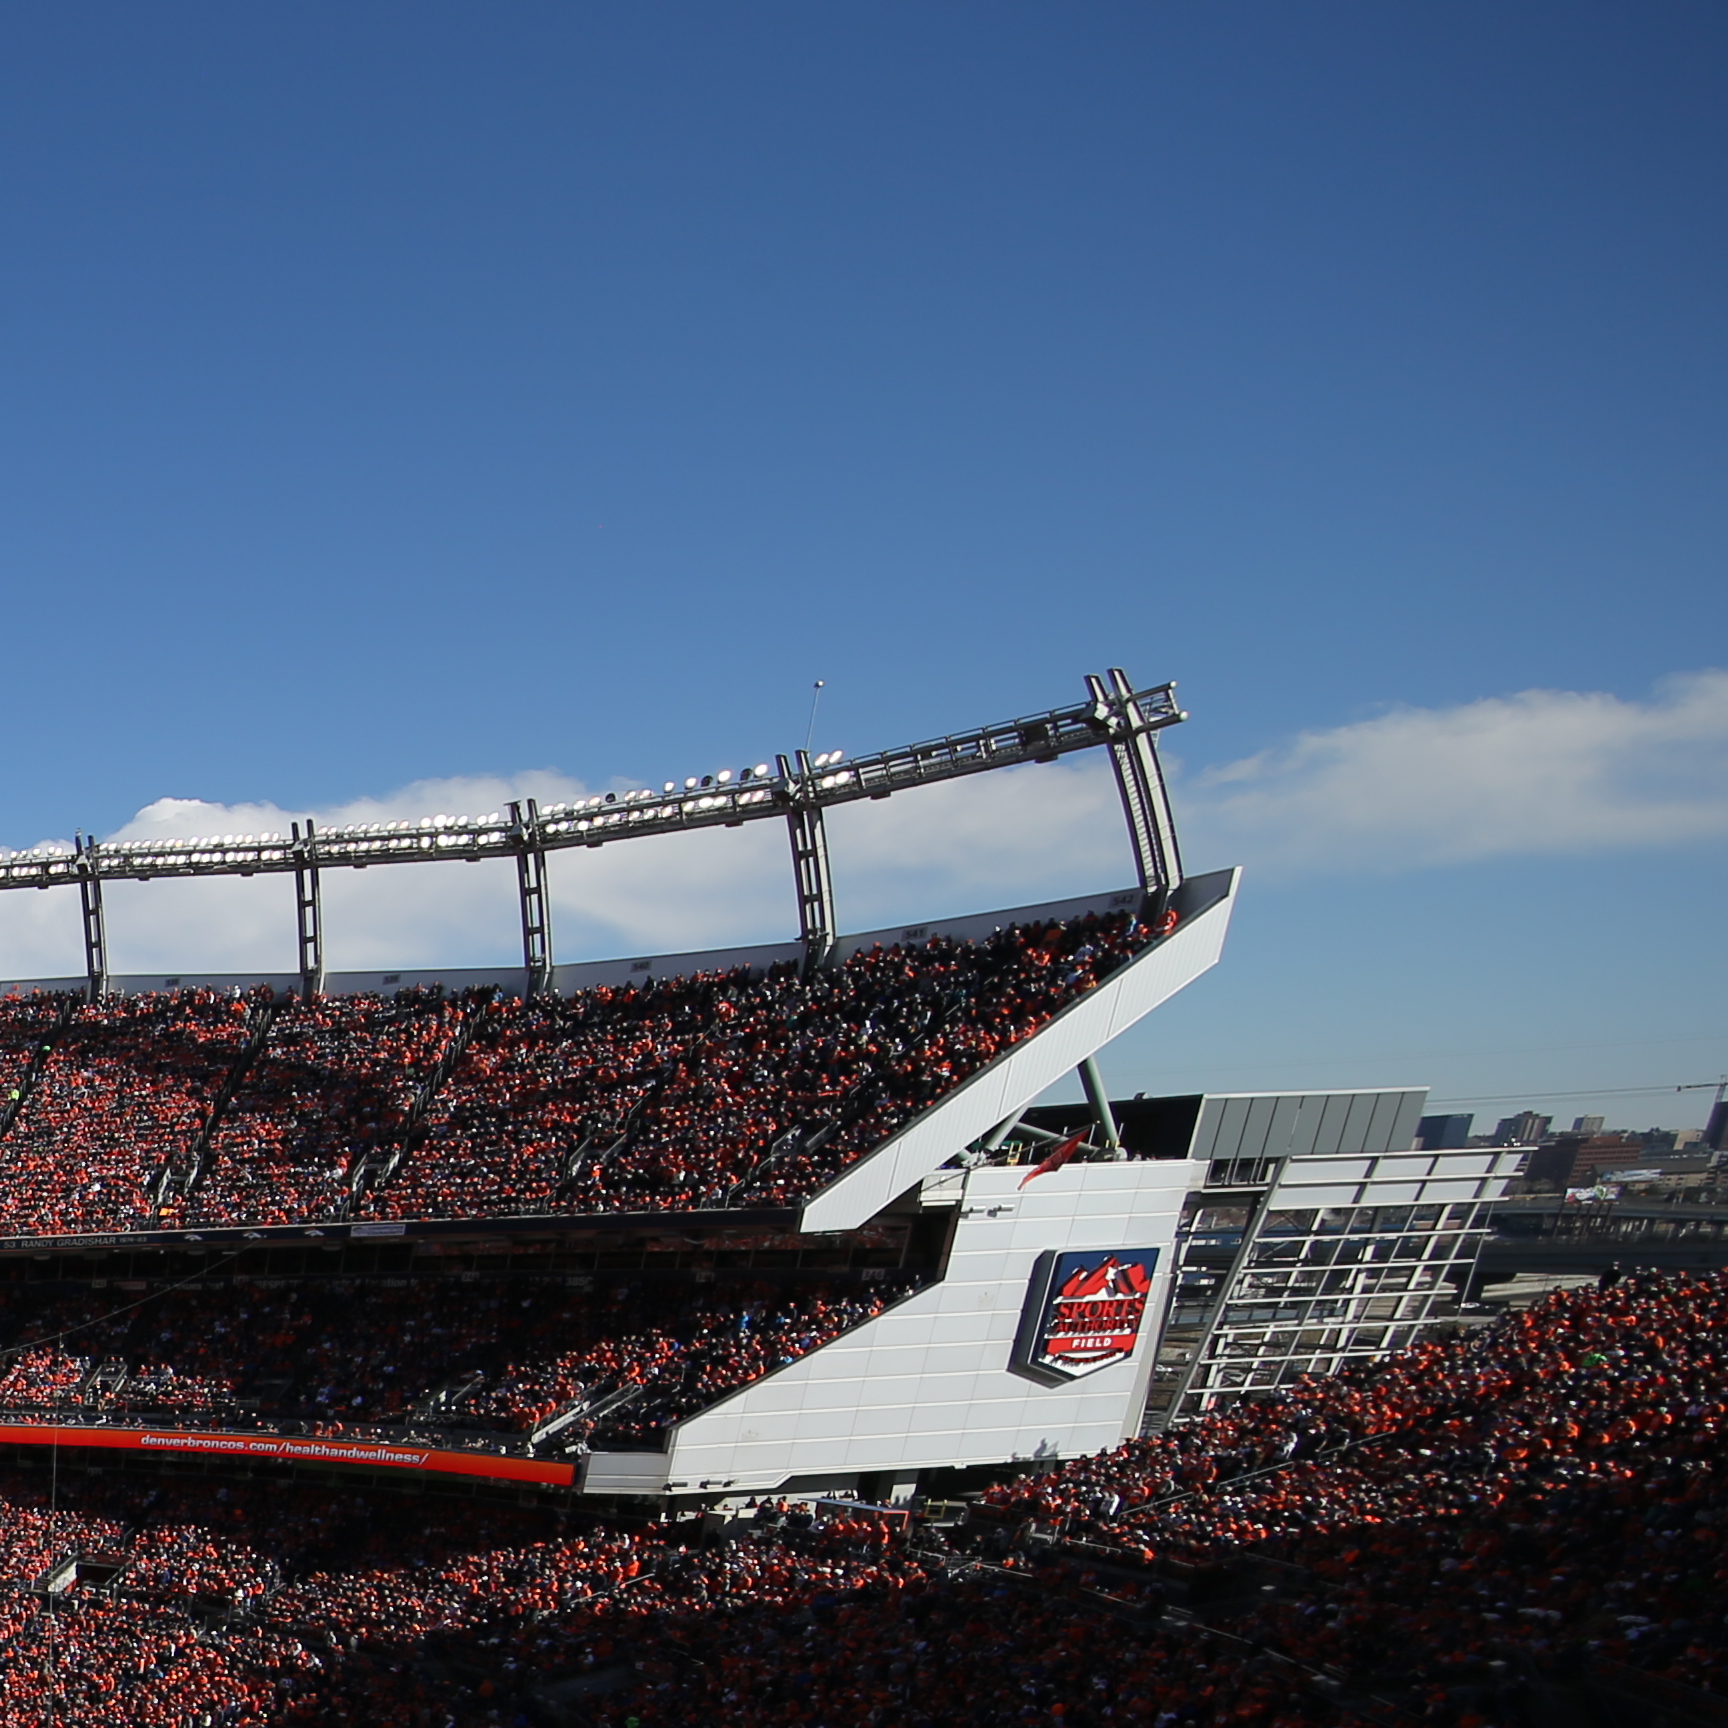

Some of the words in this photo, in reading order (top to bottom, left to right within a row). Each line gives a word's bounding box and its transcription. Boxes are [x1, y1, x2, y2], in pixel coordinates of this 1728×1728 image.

[21, 1239, 54, 1248] RANDY
[57, 1237, 116, 1247] GRADISHAR
[1057, 1299, 1145, 1319] SPORTS
[1072, 1337, 1112, 1348] FIELD
[140, 1434, 430, 1465] denverbroncos.com/healthandwellness/
